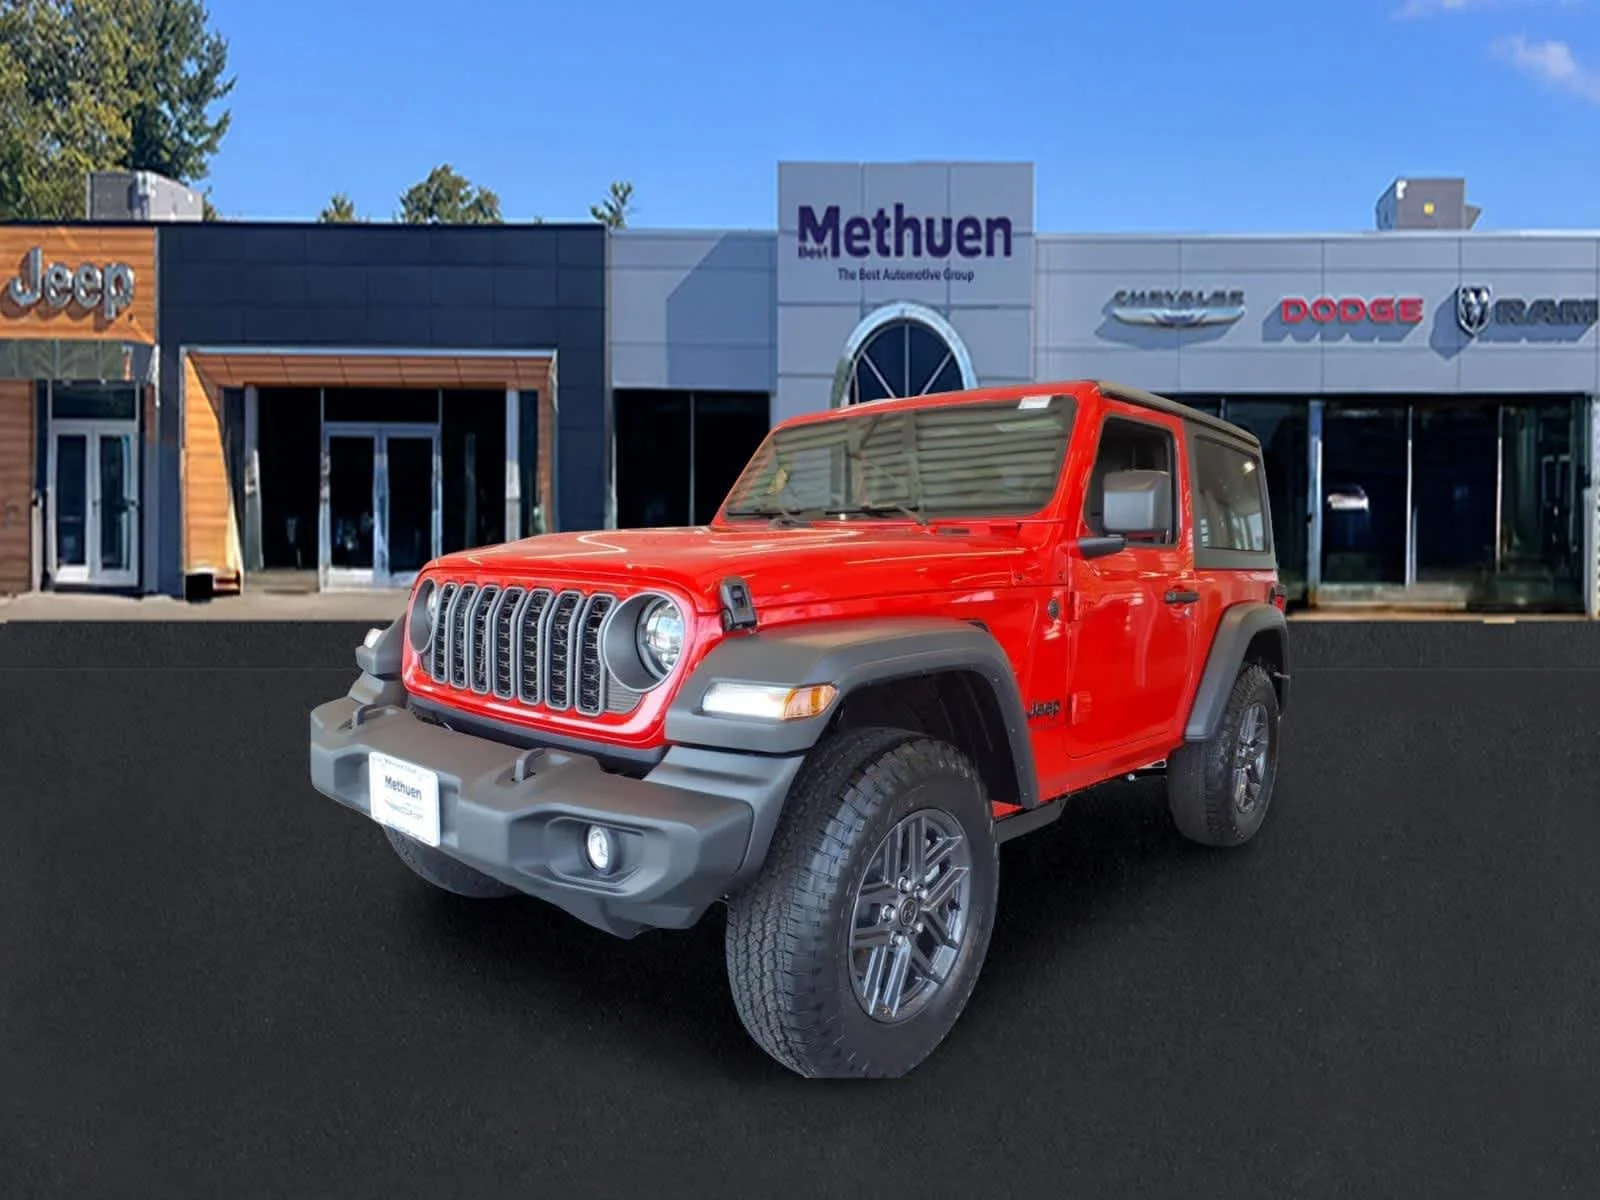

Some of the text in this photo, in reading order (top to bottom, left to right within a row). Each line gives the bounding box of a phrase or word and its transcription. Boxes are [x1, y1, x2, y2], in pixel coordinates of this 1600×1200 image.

[798, 203, 1012, 258] Methuen
[9, 247, 135, 320] Jeep
[838, 268, 974, 283] The Best Automotive Group
[1281, 298, 1424, 323] DODGE
[1495, 298, 1599, 325] RAM
[1026, 700, 1060, 719] Jeep
[384, 775, 422, 800] Methuen
